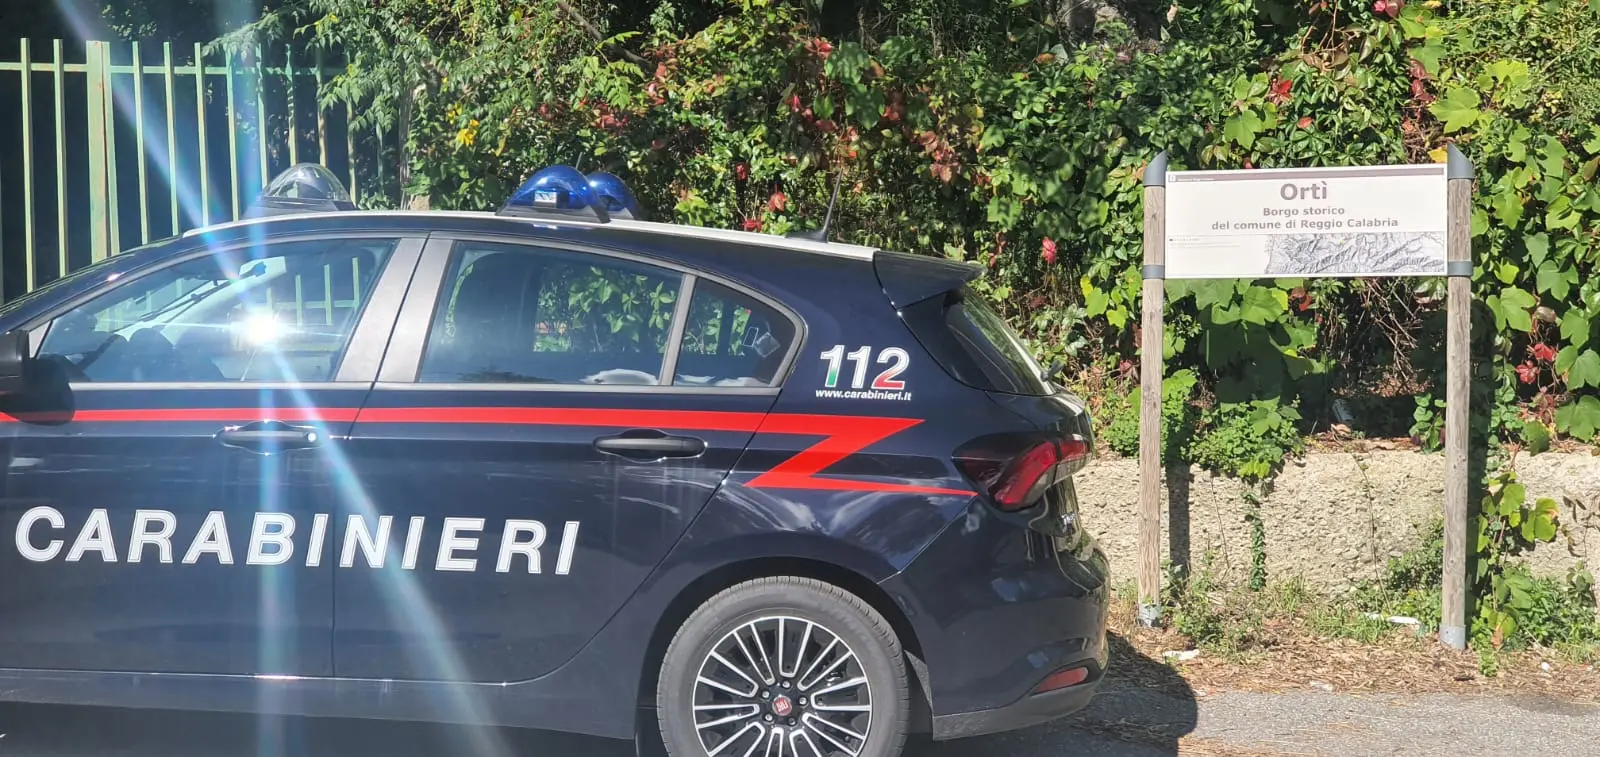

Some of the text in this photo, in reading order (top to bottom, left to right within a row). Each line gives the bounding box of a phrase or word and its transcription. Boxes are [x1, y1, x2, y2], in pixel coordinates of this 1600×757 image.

[1280, 181, 1328, 200] Ortì
[1263, 206, 1345, 218] Borgo storico
[1212, 217, 1399, 231] del comune di Reggio Calabria
[820, 344, 910, 389] 112
[815, 389, 912, 401] www.carabinieri.it
[14, 505, 581, 576] CARABINIERI
